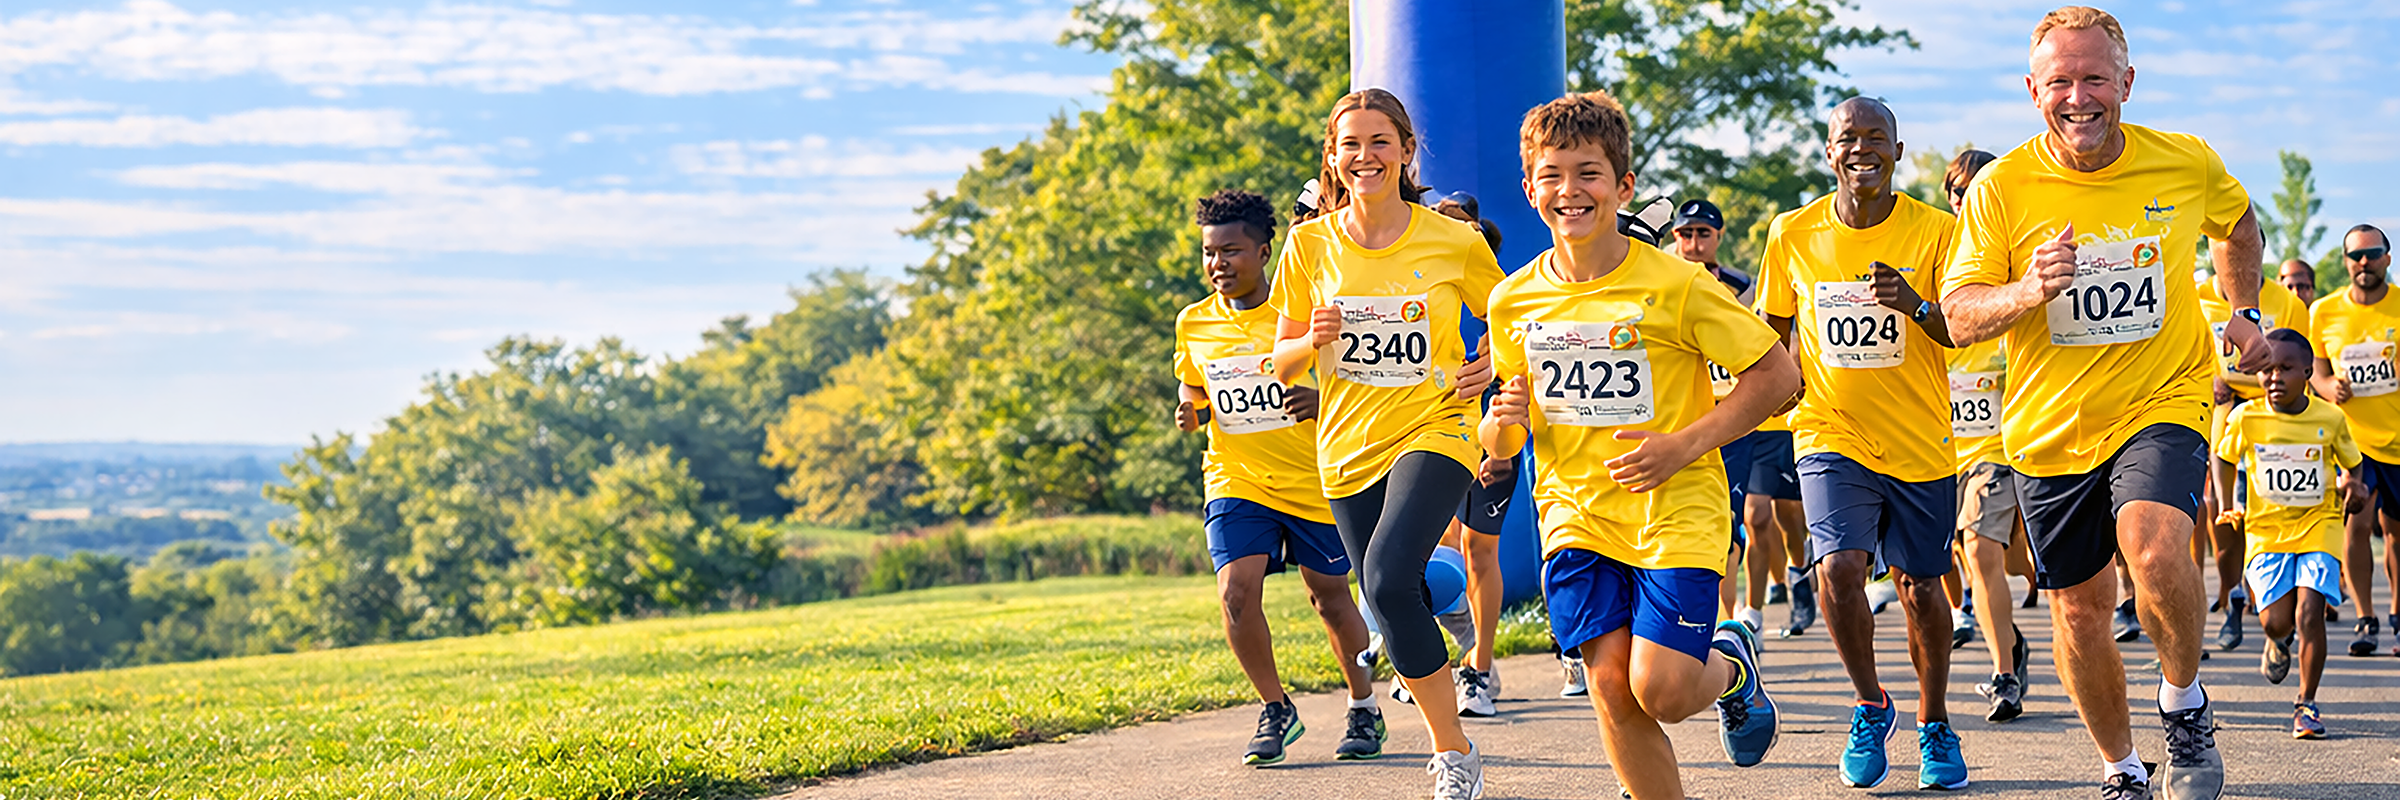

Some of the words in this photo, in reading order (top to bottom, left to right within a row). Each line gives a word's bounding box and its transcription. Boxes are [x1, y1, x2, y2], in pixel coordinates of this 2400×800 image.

[2066, 276, 2157, 321] 1024
[1340, 332, 1427, 365] 2340
[1542, 360, 1641, 399] 2423
[1218, 382, 1284, 414] 0340
[2265, 468, 2319, 492] 1024
